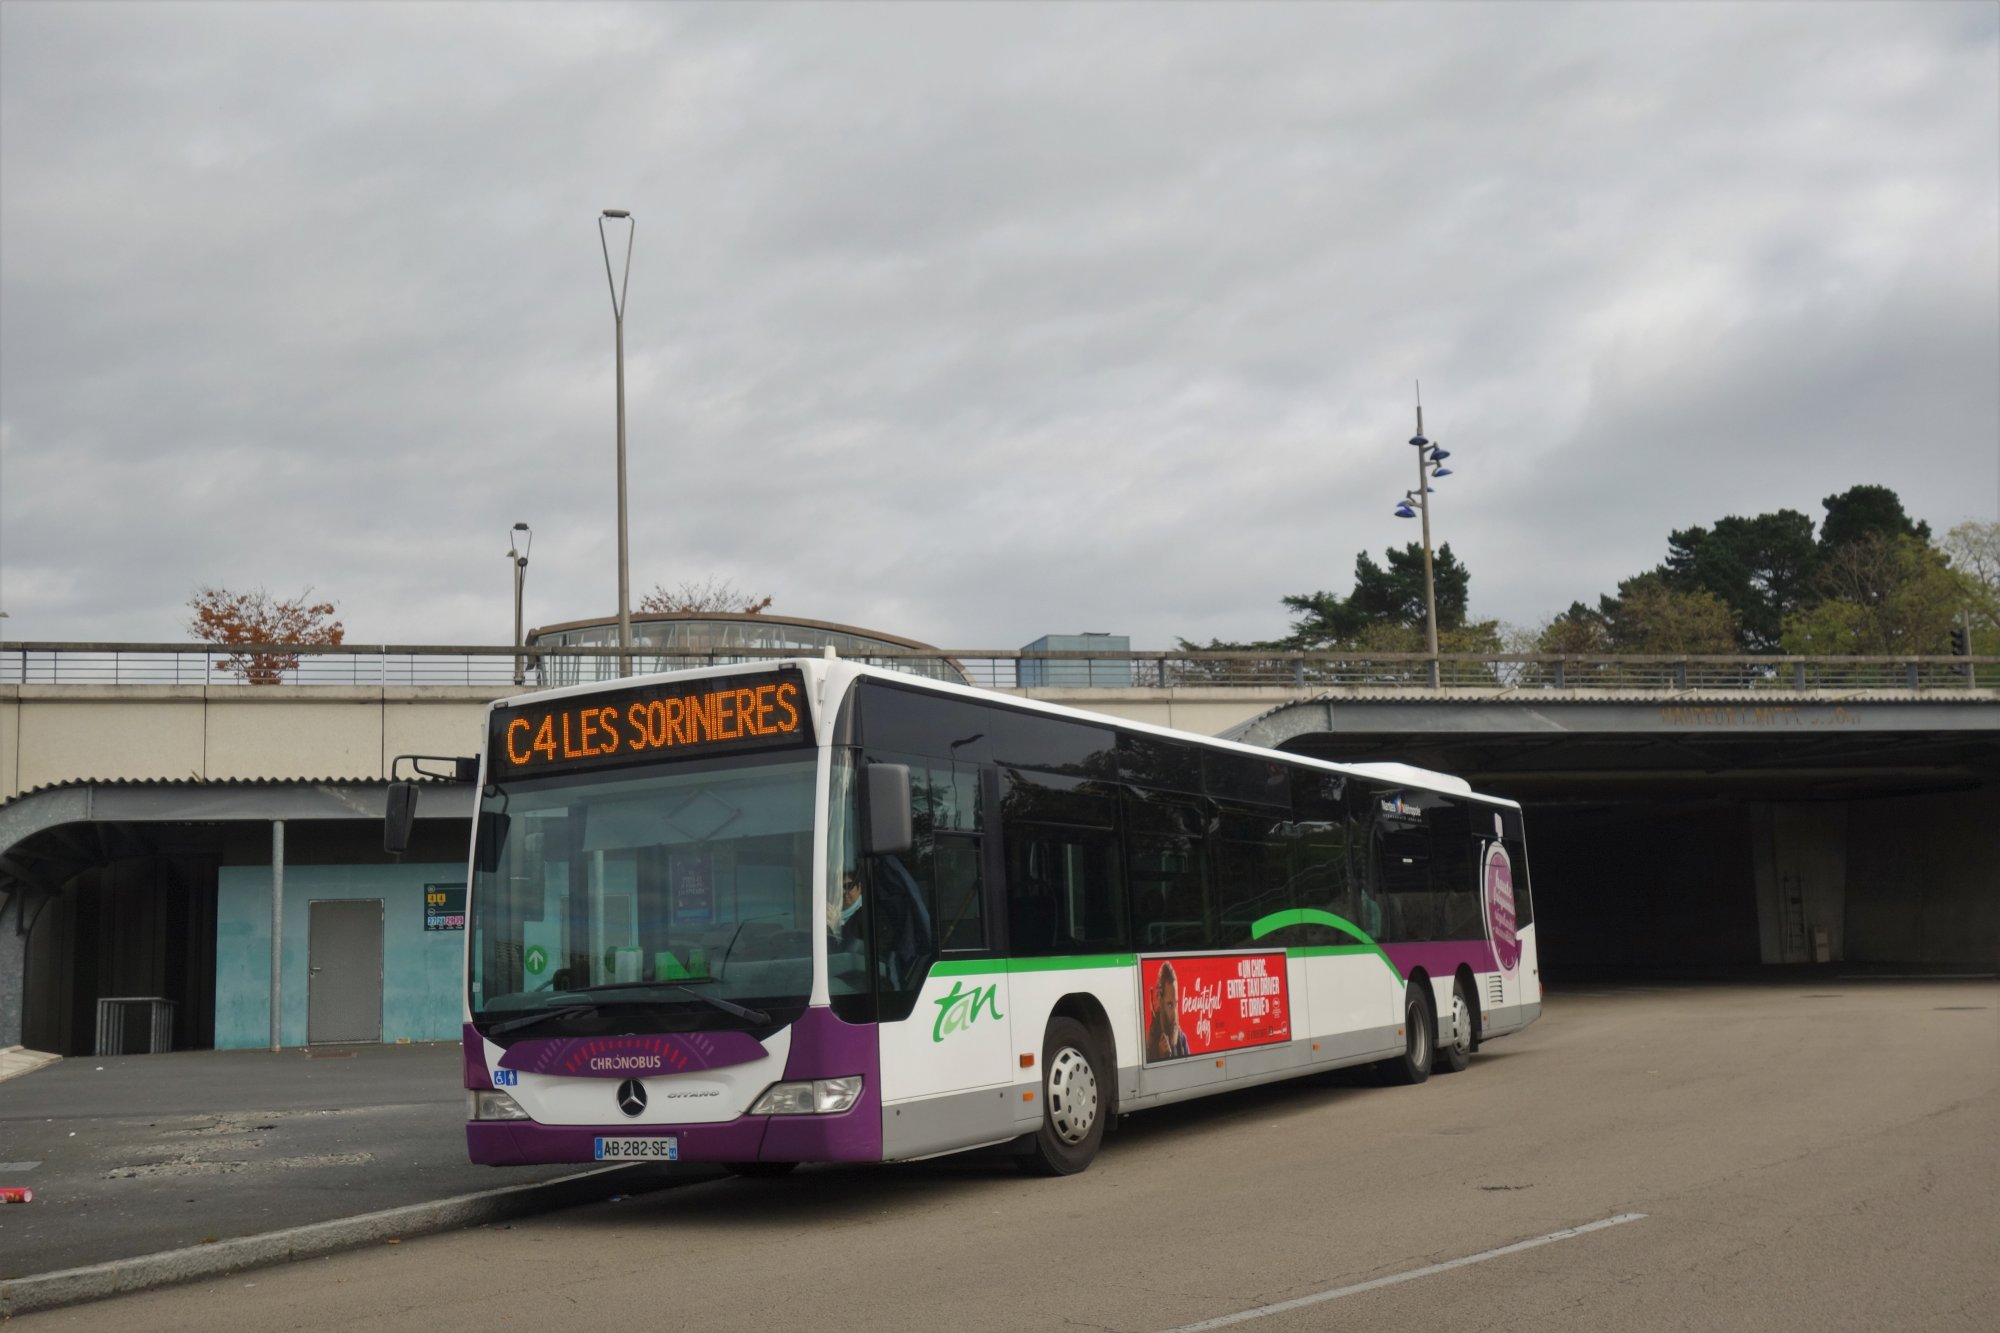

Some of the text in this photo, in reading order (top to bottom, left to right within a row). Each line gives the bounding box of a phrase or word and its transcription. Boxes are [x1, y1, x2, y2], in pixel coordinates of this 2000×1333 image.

[507, 683, 798, 765] C4 LES SORINIERES
[1181, 980, 1222, 1019] beautiful
[1195, 977, 1201, 992] a
[1227, 976, 1280, 999] ENTRE TAXI DRIVER
[932, 980, 1004, 1043] tan
[1240, 998, 1248, 1018] ET
[1196, 1010, 1211, 1047] day
[603, 1140, 668, 1157] AB-282-SE
